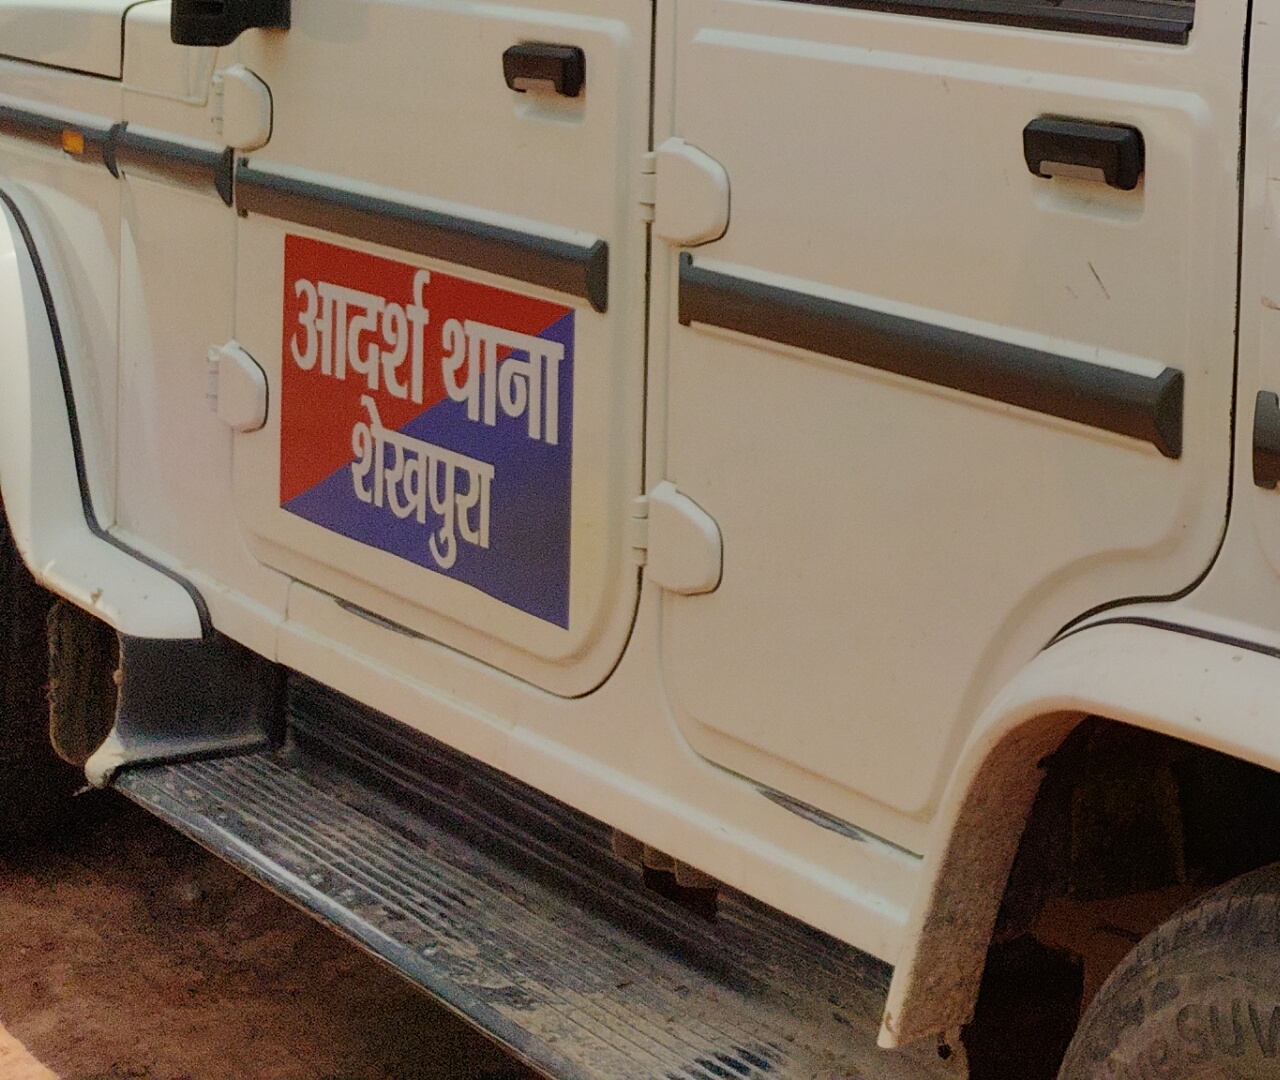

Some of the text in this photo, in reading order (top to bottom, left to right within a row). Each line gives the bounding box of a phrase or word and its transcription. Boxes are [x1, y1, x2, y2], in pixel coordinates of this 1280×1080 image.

[290, 269, 565, 446] आदर्श थाना
[350, 394, 495, 570] शेखपुरा
